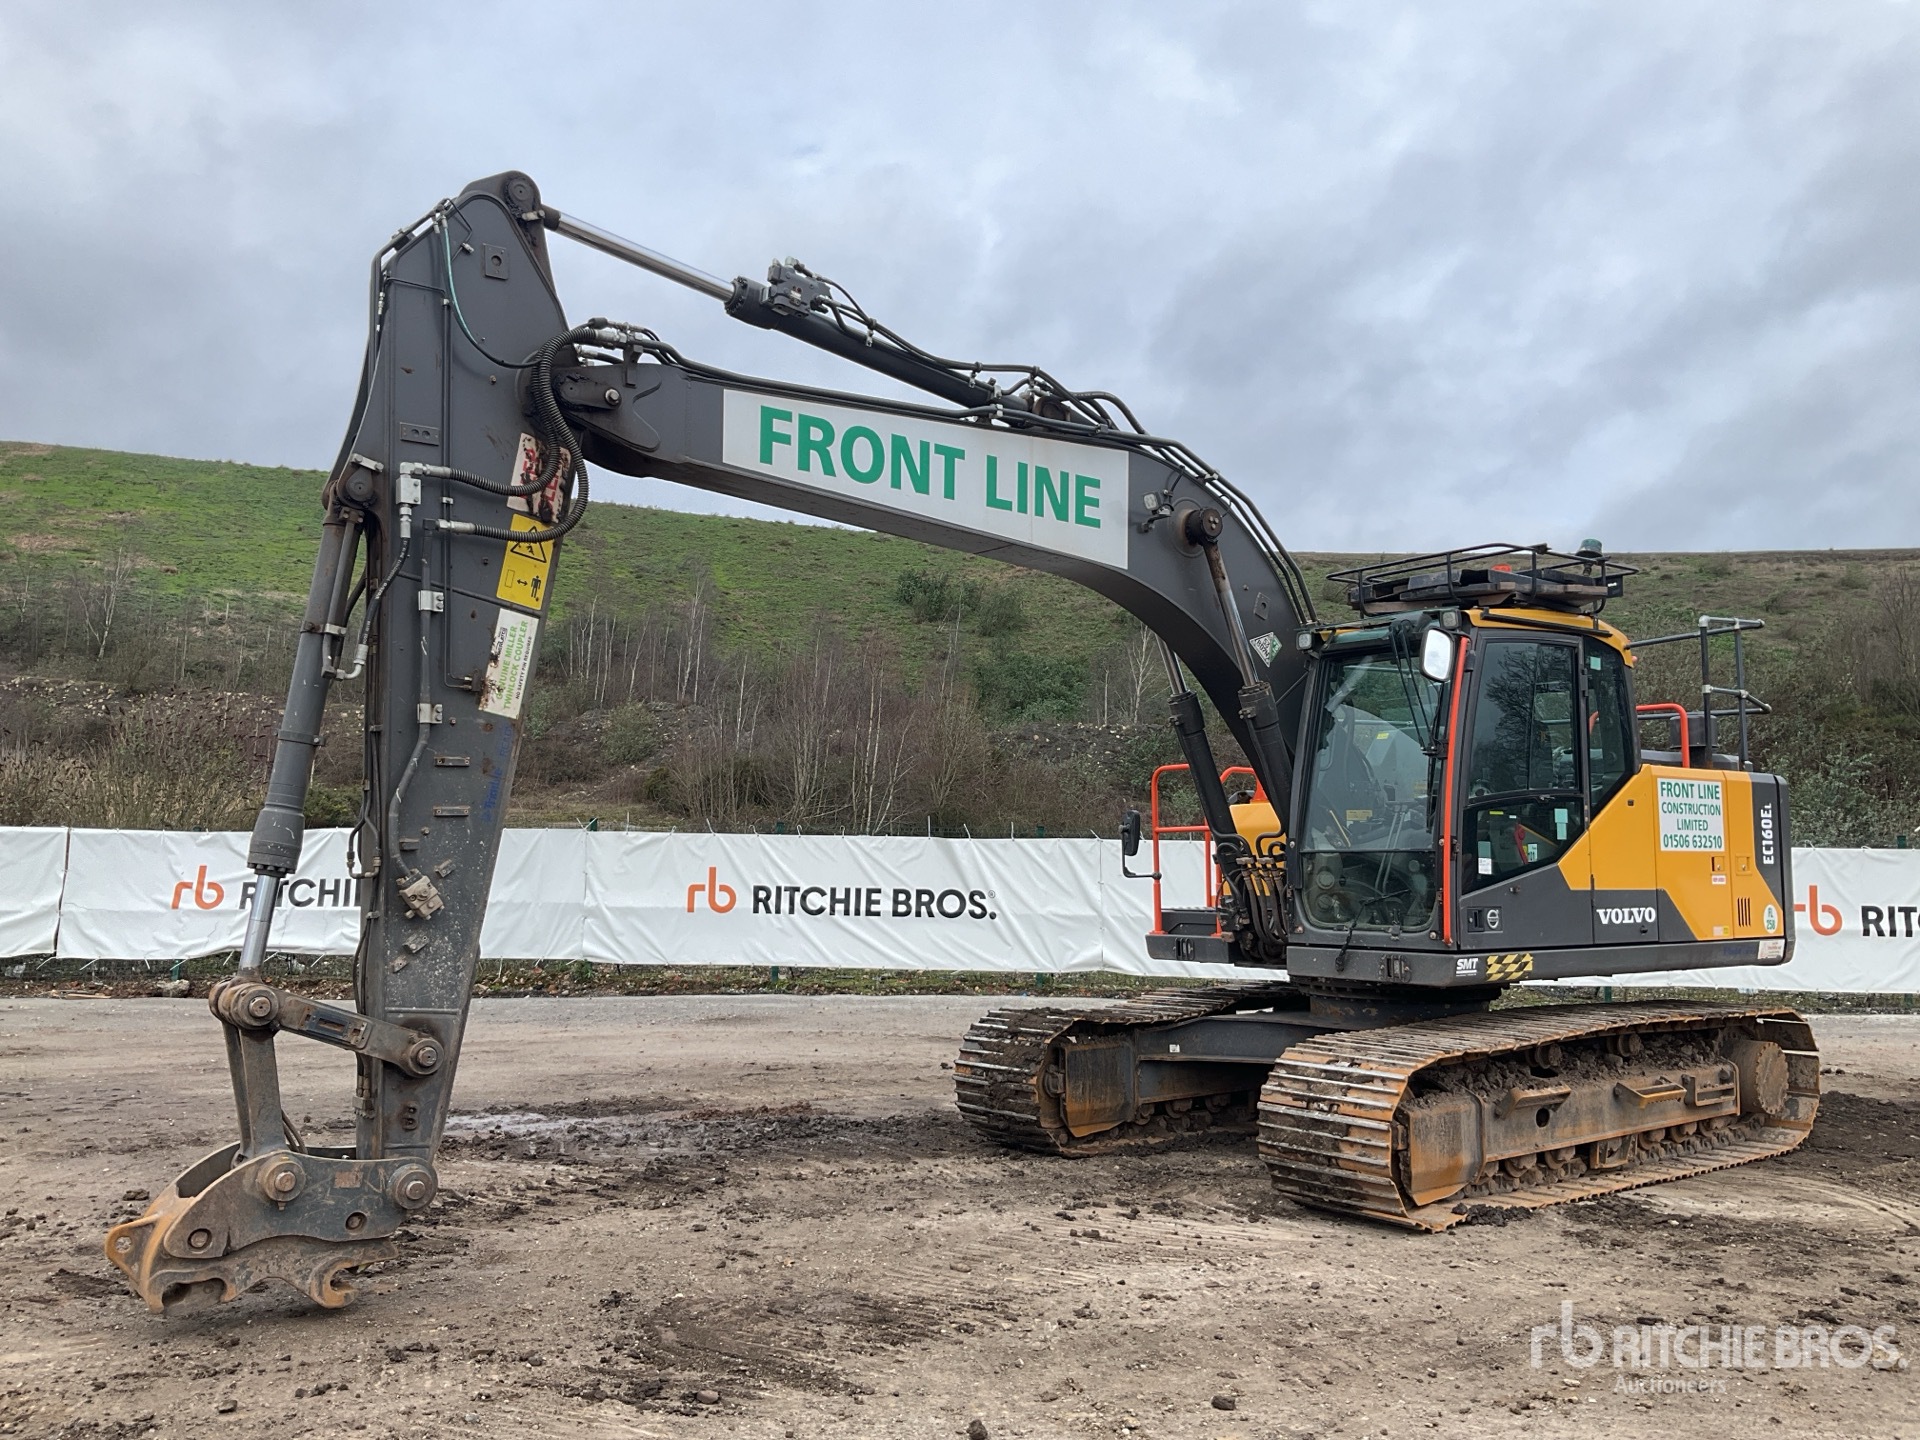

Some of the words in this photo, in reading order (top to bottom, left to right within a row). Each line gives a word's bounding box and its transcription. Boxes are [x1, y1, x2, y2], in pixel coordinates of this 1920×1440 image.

[760, 405, 965, 500] FRONT
[986, 455, 1101, 528] LINE
[505, 625, 518, 657] MILLER
[503, 664, 519, 709] TWINLOCK
[514, 620, 528, 661] COUPLER
[1660, 782, 1695, 798] FRONT
[1698, 784, 1720, 800] LINE
[1662, 802, 1721, 816] CONSTRUCTION
[1677, 819, 1709, 831] LIMITED
[1663, 834, 1690, 848] 01506
[1692, 835, 1723, 848] 632510
[687, 867, 737, 914] rb
[752, 885, 881, 917] RITCHIE
[1596, 907, 1656, 924] VOLVO
[1861, 905, 1920, 938] RIT
[1456, 957, 1479, 971] SMT
